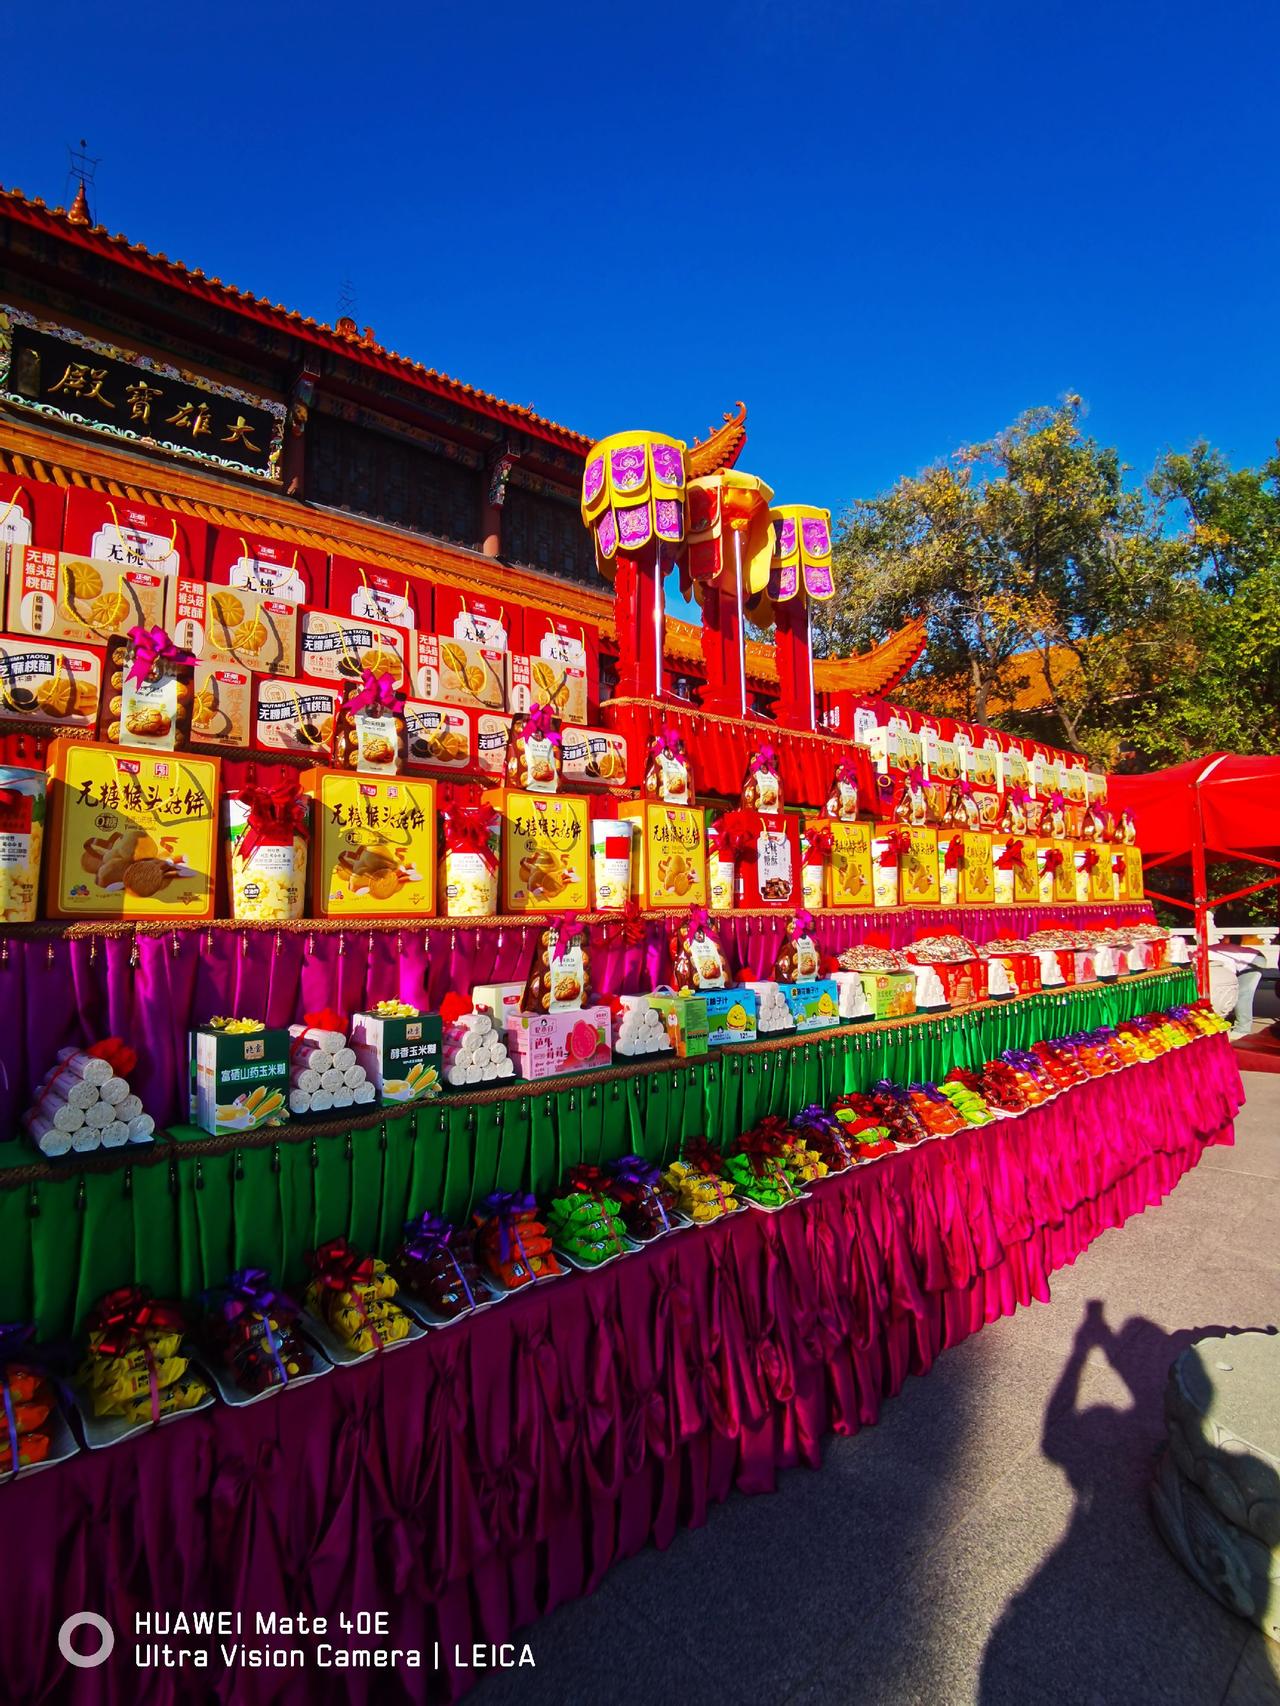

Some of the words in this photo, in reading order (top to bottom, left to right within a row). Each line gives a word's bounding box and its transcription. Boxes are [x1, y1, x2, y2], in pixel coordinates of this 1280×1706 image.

[26, 549, 56, 566] 无糖
[25, 561, 56, 579] 猴头菇
[25, 575, 55, 592] 桃酥
[179, 580, 205, 596] 无糖
[178, 591, 205, 608] 猴头菇
[178, 604, 203, 619] 桃酥
[220, 1062, 286, 1083] 富硒山药玉米糊
